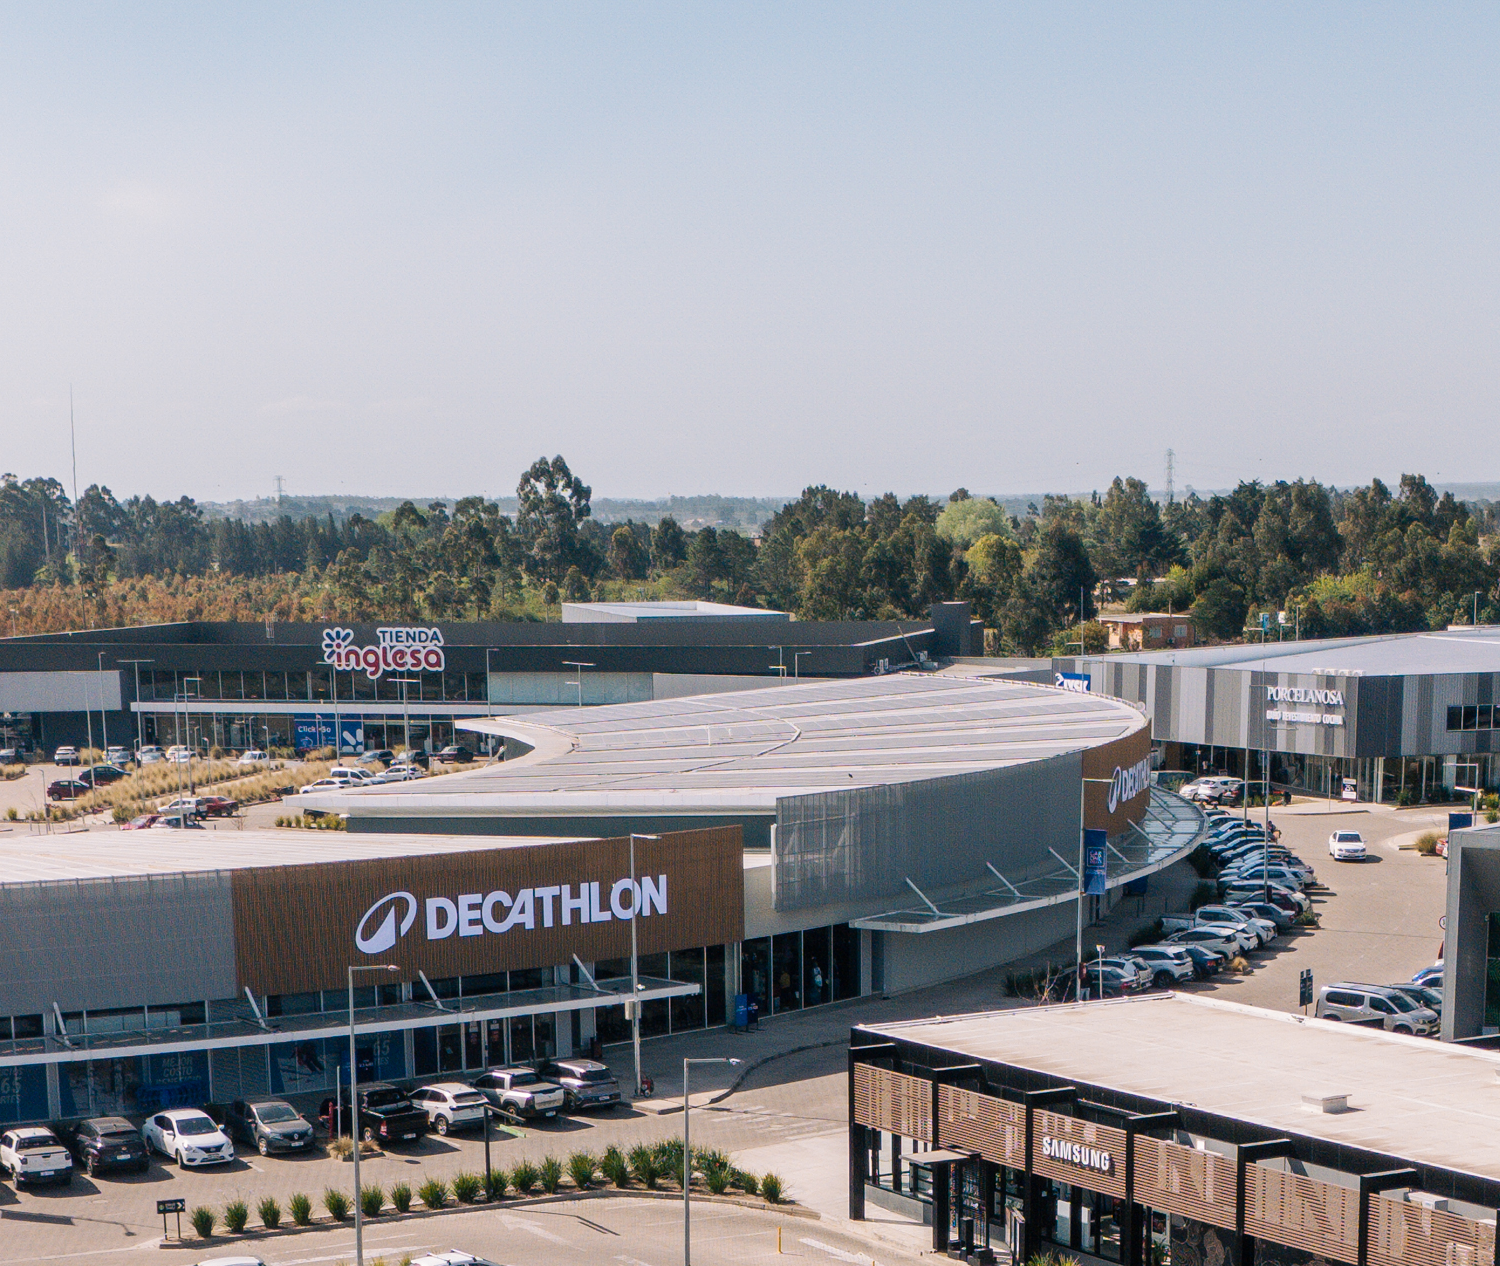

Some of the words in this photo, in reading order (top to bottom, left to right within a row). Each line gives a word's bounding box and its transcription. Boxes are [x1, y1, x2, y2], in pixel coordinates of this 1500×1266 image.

[379, 630, 441, 643] TIENDA
[335, 640, 443, 677] inglesa
[1267, 686, 1344, 705] PORCELANOSA
[425, 874, 668, 941] DECATHLON
[1042, 1136, 1110, 1171] SAMSUNG
